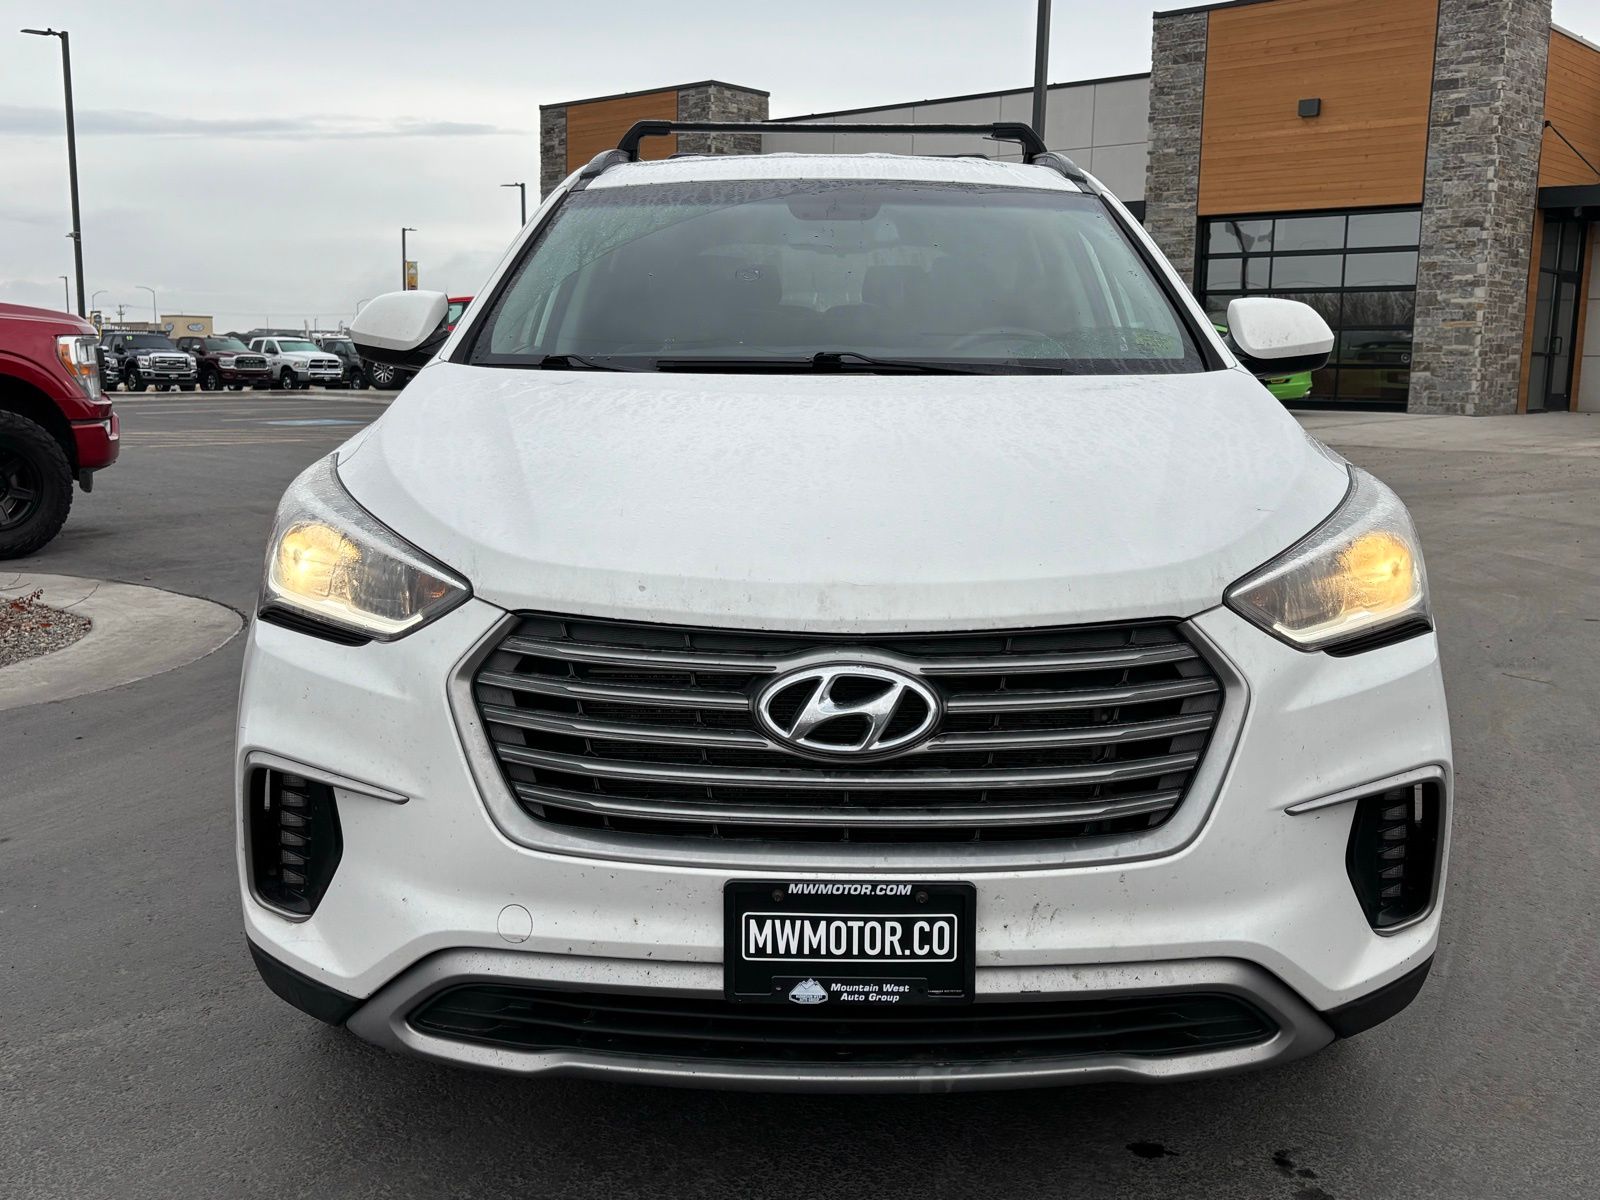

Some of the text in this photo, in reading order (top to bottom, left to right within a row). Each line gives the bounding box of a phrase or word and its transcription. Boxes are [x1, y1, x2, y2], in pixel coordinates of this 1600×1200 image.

[788, 883, 912, 896] MWMOTOR.COM
[749, 919, 950, 956] MWMOTOR.CO
[830, 983, 910, 993] Mountain West
[840, 993, 900, 1003] Auto Group
